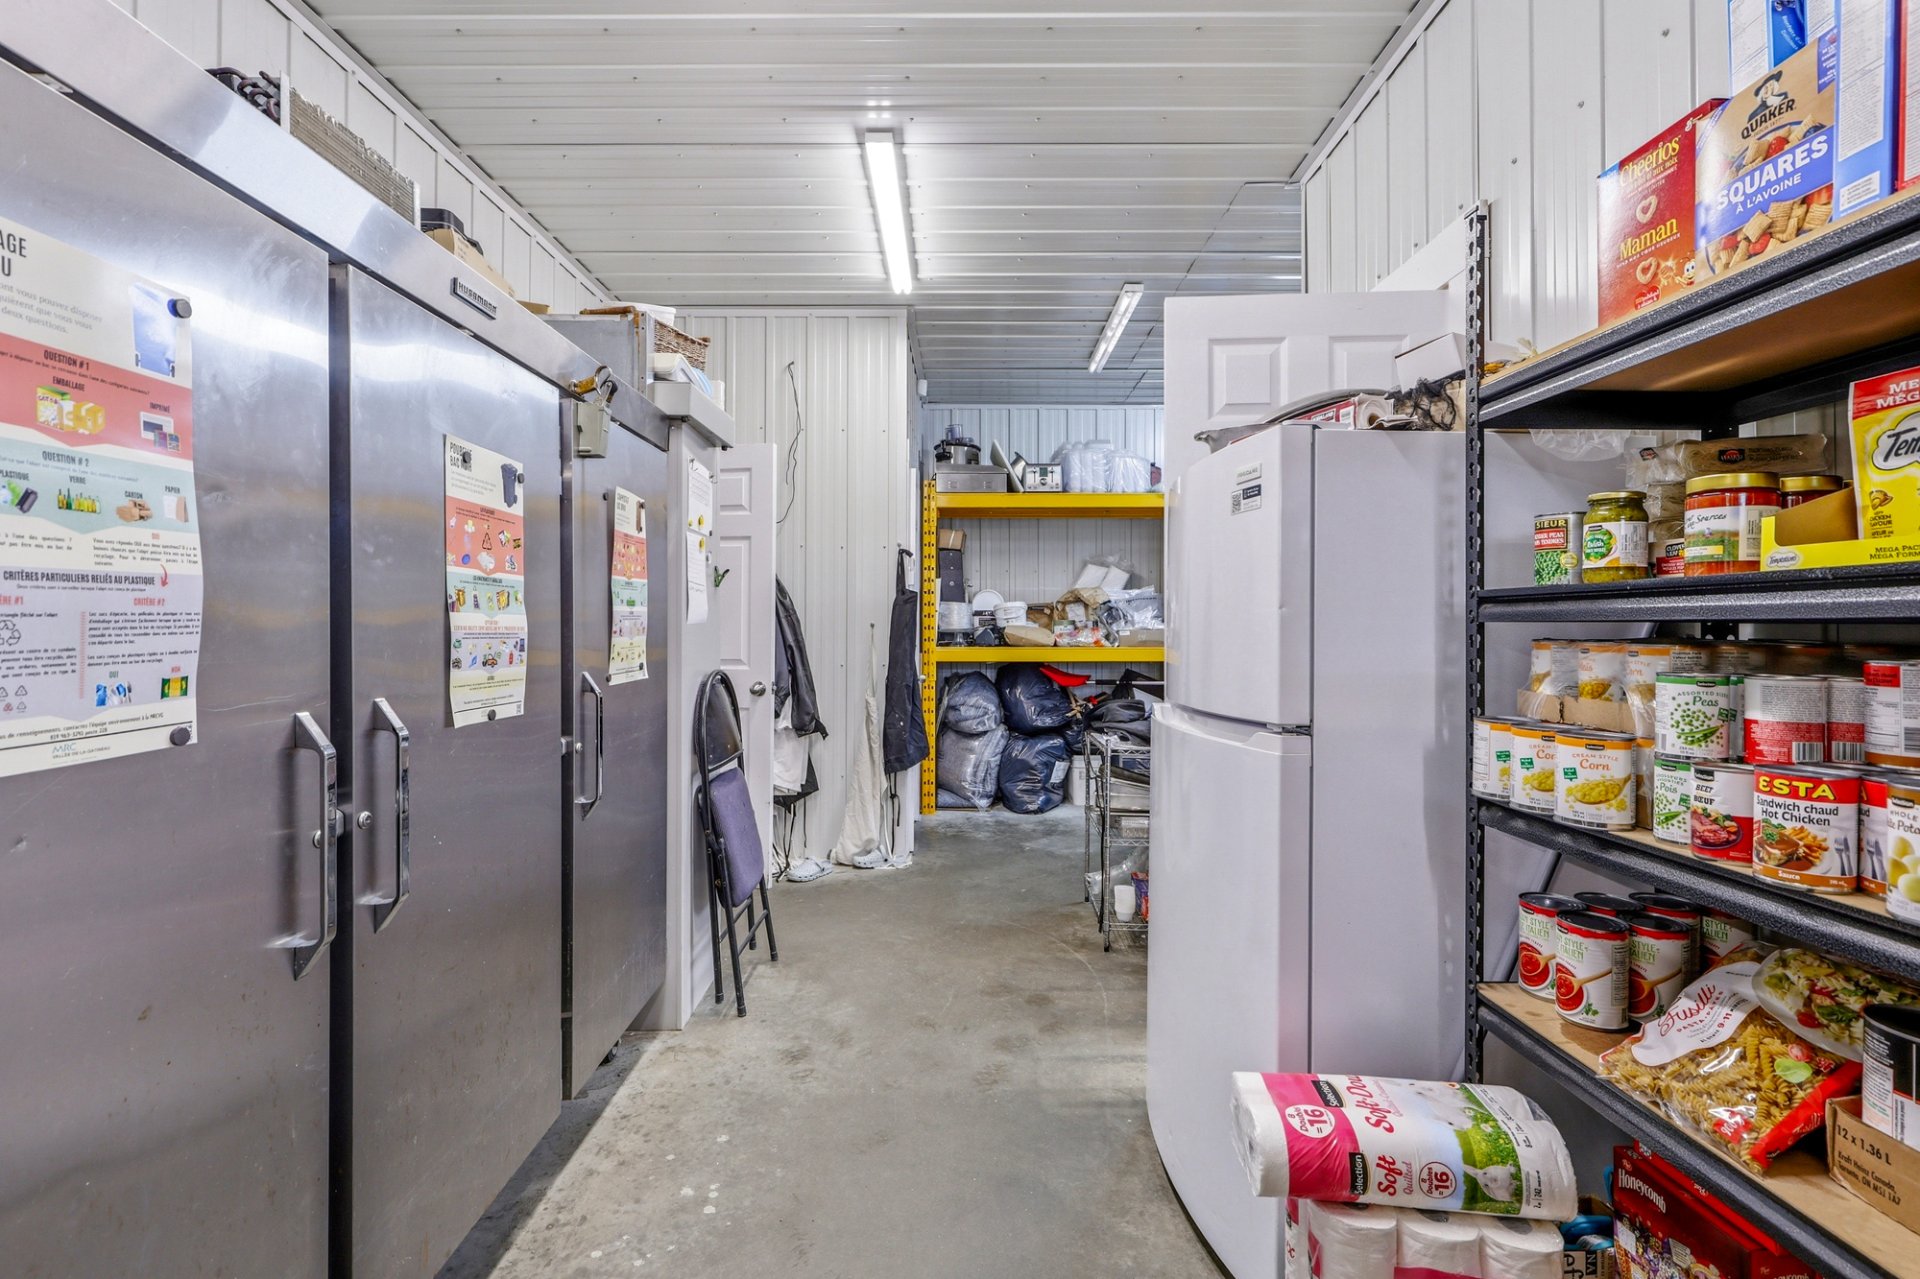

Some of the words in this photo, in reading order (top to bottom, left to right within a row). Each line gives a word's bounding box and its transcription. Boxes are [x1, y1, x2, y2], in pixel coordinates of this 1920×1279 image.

[1741, 98, 1796, 139] QUAKER
[1620, 136, 1680, 187] Cheerios
[1717, 135, 1829, 210] SQUARES
[1747, 173, 1802, 208] L'AVOINE
[1620, 218, 1678, 260] Maman
[43, 349, 77, 368] QUESTION
[52, 375, 86, 392] EMBALLAGE
[41, 450, 76, 464] QUESTION
[69, 475, 87, 485] VERRE
[124, 491, 143, 500] CARTON
[164, 486, 181, 494] PAPIER
[3, 569, 39, 582] CRITÈRES
[40, 572, 90, 584] PARTICULIERS
[91, 572, 113, 584] RELIÉS
[114, 575, 123, 584] AU
[124, 575, 155, 586] PLASTIQUE
[1692, 696, 1719, 707] Peas
[1536, 749, 1556, 760] Cor
[1580, 759, 1610, 771] Corn
[1660, 782, 1678, 793] Pois
[1758, 775, 1835, 800] ESTA
[1757, 795, 1800, 812] Sandwich
[1804, 804, 1839, 816] chaud
[1761, 807, 1779, 819] Hot
[1781, 810, 1831, 826] Chicken
[1778, 870, 1801, 880] Sauce
[1530, 918, 1550, 930] STYLE
[1705, 919, 1728, 930] STYLE
[1564, 938, 1585, 951] STYLE
[1631, 940, 1656, 952] STYLE
[1657, 983, 1717, 1037] Fusilli
[1717, 1012, 1733, 1030] 9-11
[1320, 1080, 1340, 1107] Selection
[1837, 1124, 1849, 1140] 12
[1851, 1135, 1857, 1146] x
[1860, 1138, 1882, 1159] 1.36
[1885, 1152, 1892, 1166] L
[1354, 1155, 1364, 1194] Selection
[1376, 1154, 1403, 1197] Soft
[1402, 1160, 1414, 1195] Quilted
[1618, 1168, 1666, 1214] Honeycomb
